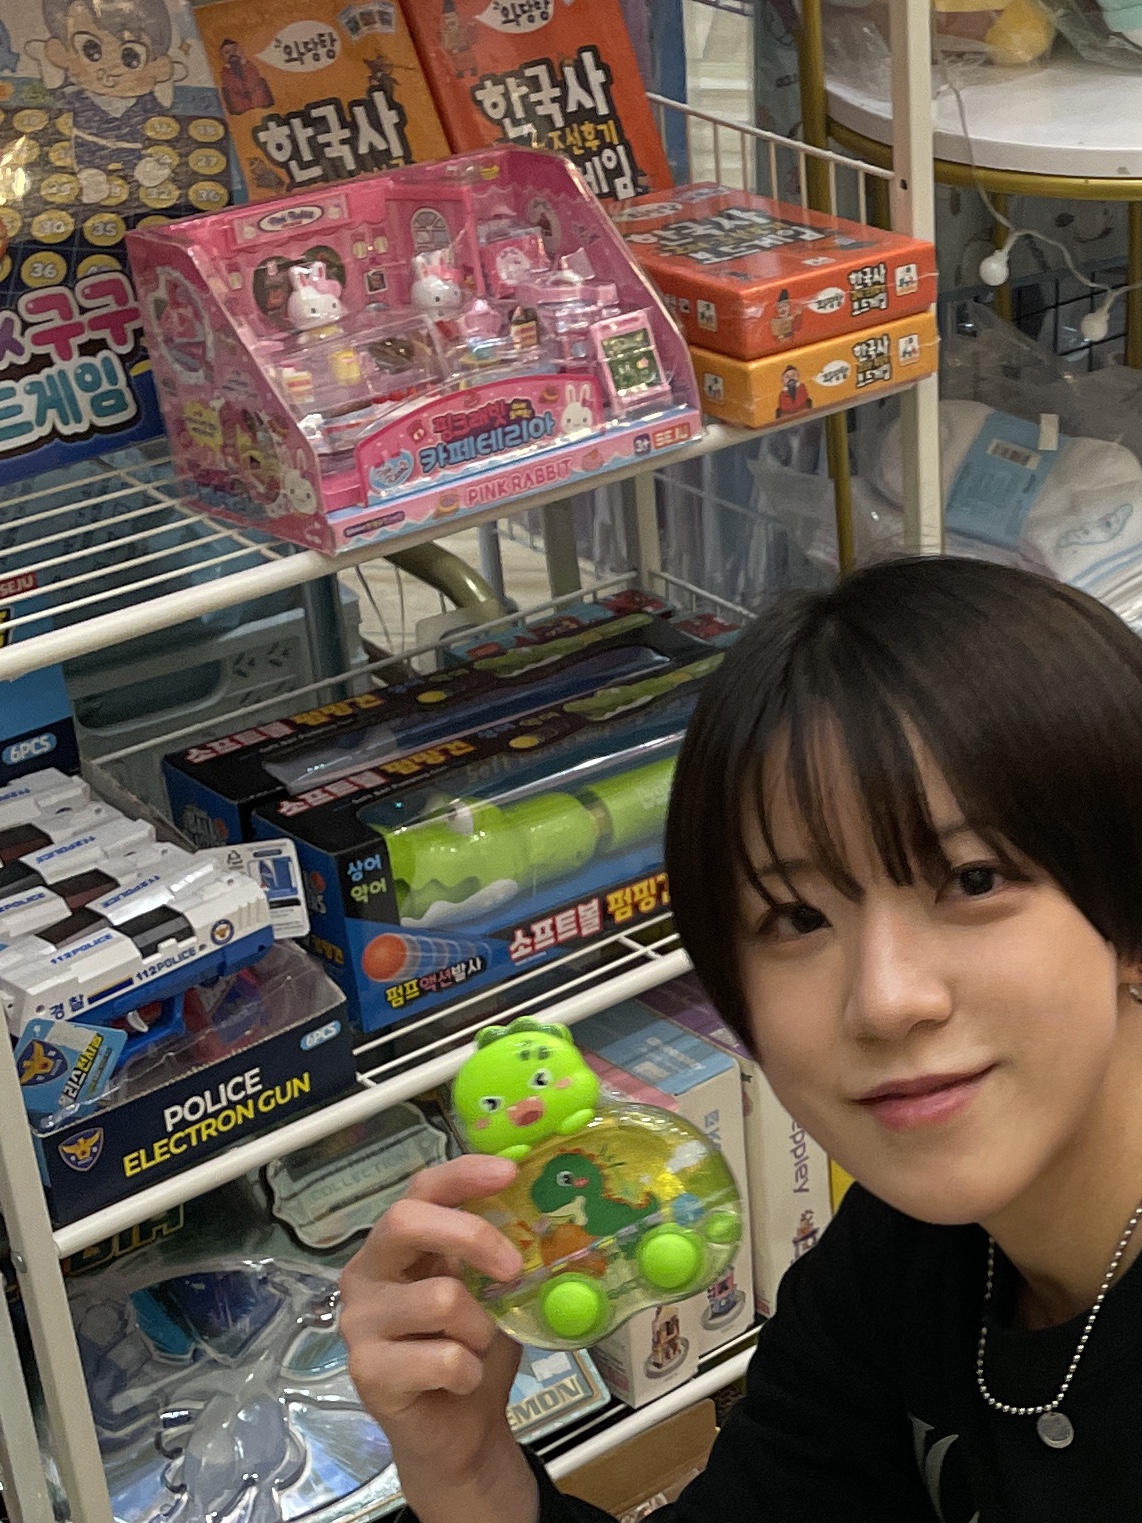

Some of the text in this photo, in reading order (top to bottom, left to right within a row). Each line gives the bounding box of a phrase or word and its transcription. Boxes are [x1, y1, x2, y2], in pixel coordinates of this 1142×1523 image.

[475, 50, 611, 138] 한국사
[256, 90, 402, 185] 한국사
[92, 222, 117, 236] 35
[30, 262, 56, 278] 36
[418, 412, 556, 474] 카페테리아
[466, 459, 573, 507] PINK RABBIT
[0, 573, 36, 597] SEJU
[10, 735, 51, 764] 6PCS
[346, 854, 382, 882] 상어
[350, 878, 387, 904] 악어
[508, 897, 602, 961] 소프트볼
[50, 932, 113, 965] 112POLICE
[135, 946, 196, 982] 112POLICE
[48, 993, 87, 1020] 경찰
[304, 1022, 339, 1049] 6PCS
[163, 1065, 263, 1133] POLICE
[122, 1072, 312, 1178] ELECTRON GUN
